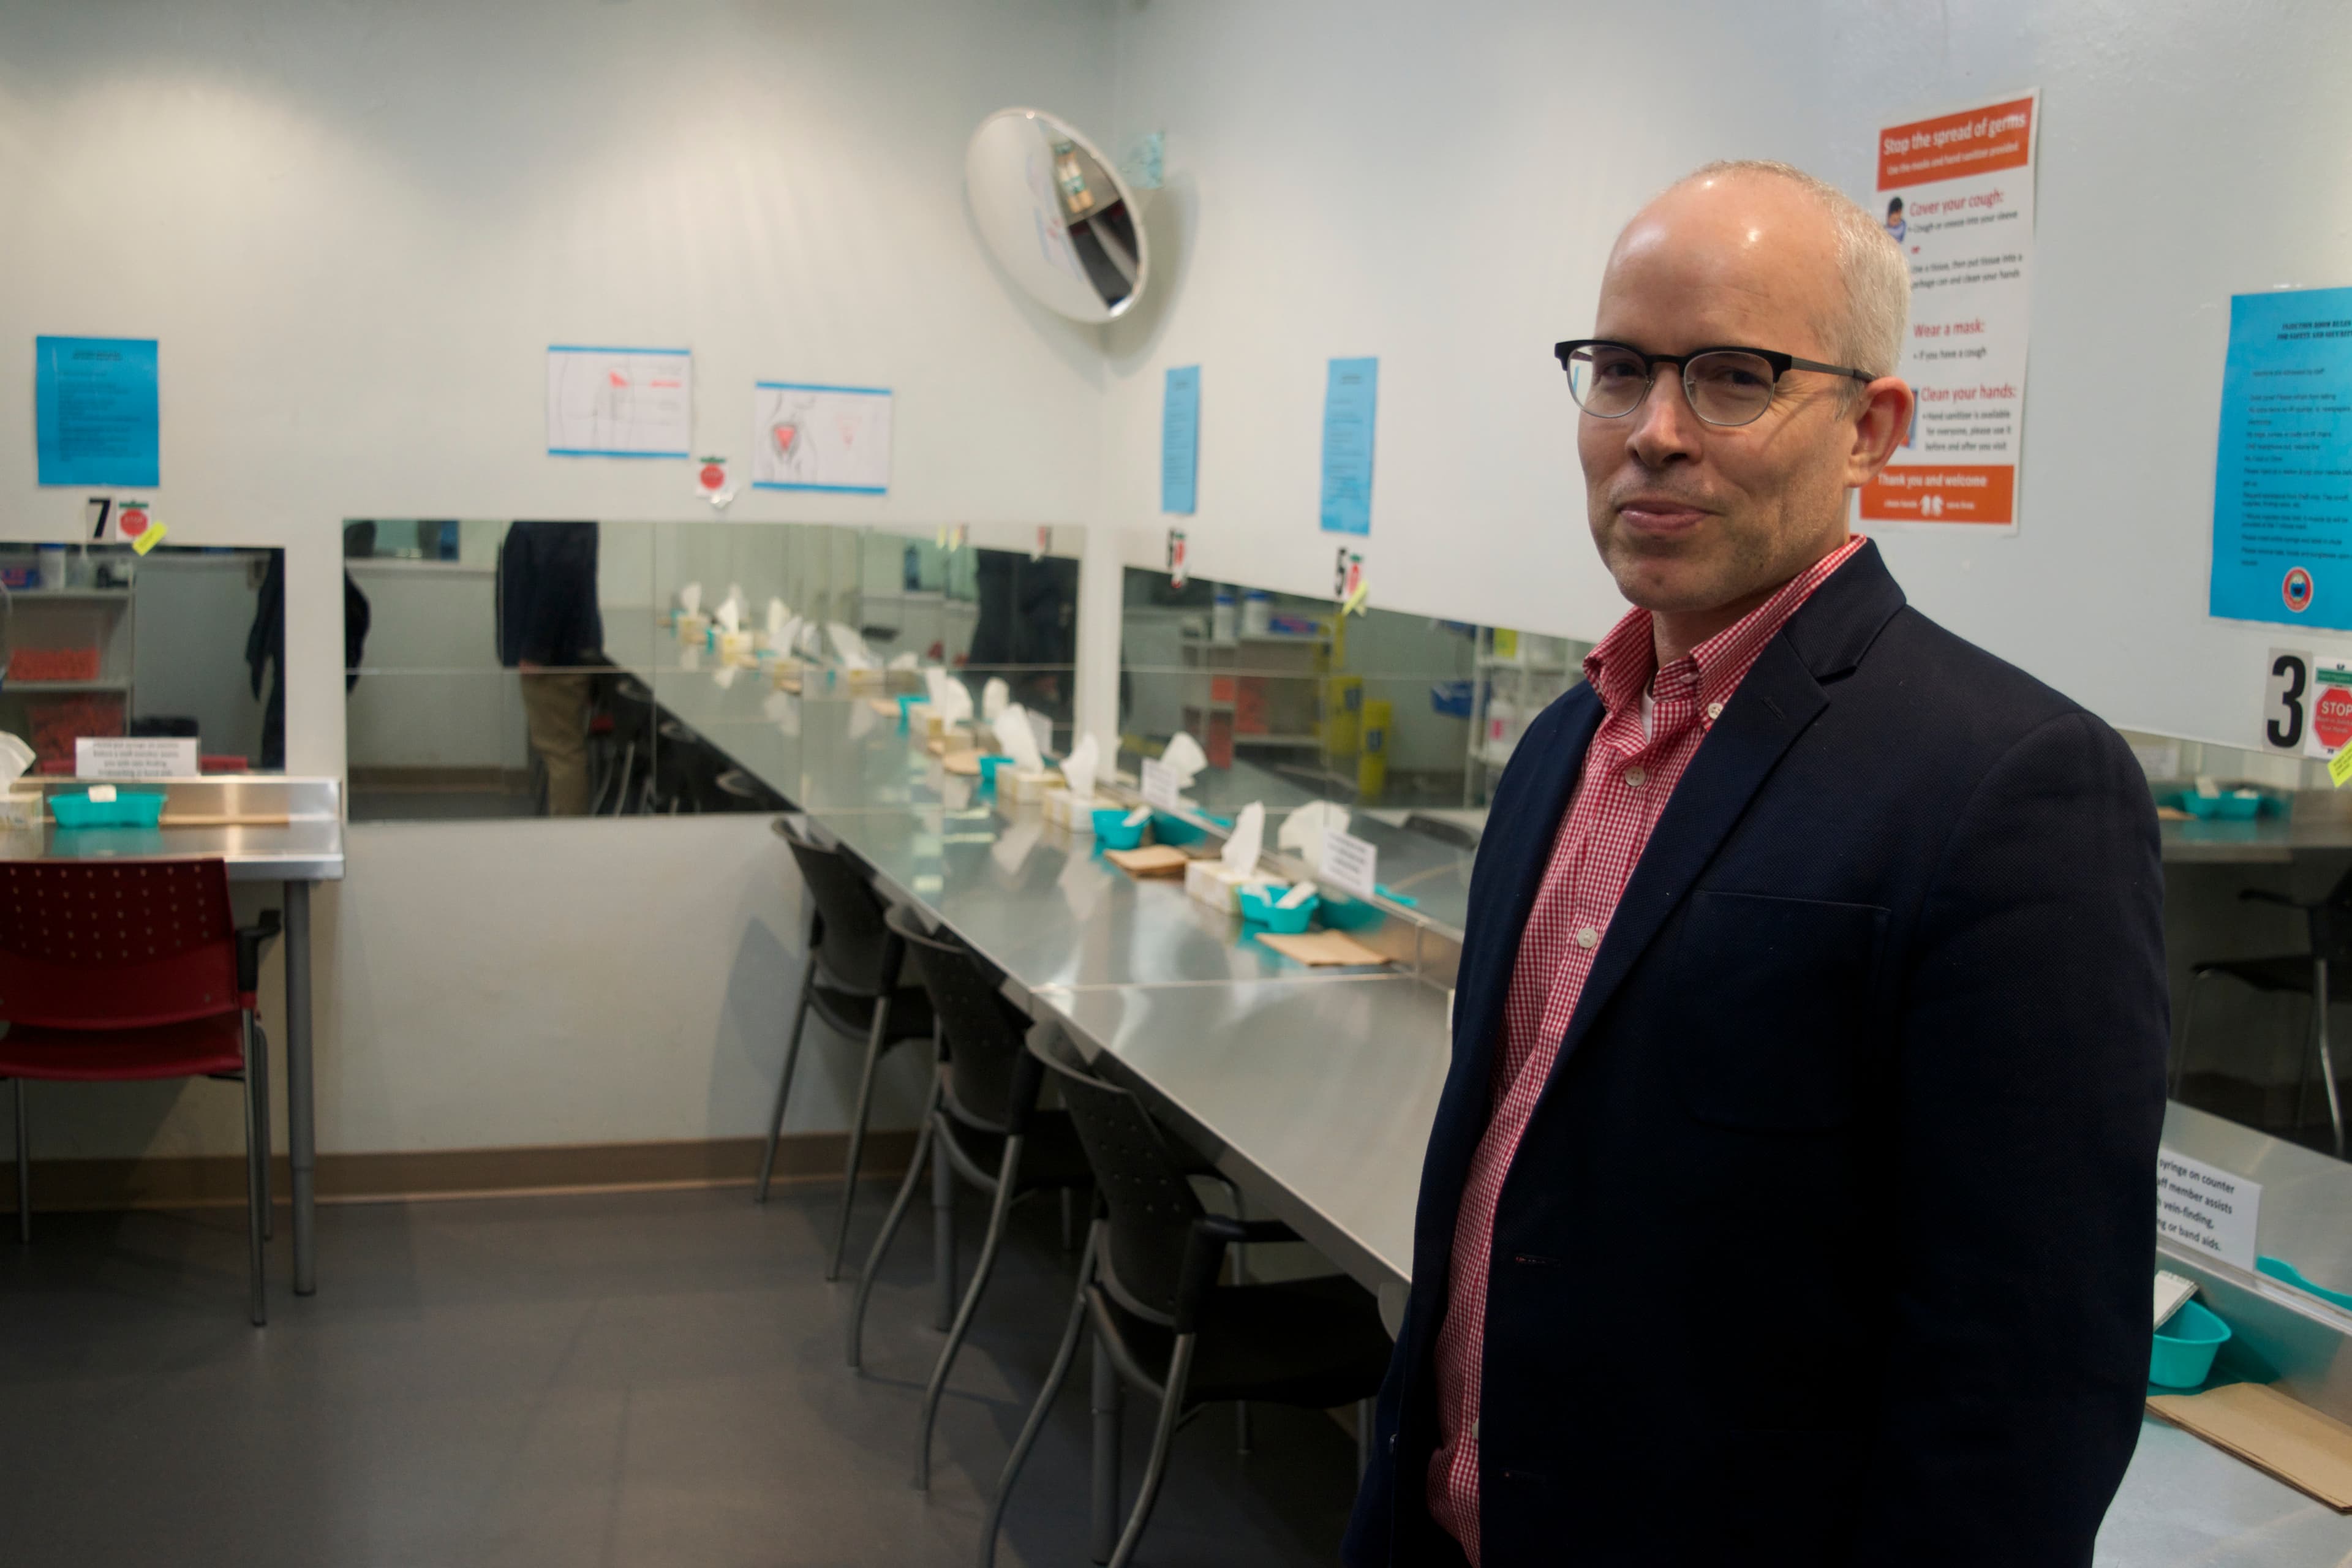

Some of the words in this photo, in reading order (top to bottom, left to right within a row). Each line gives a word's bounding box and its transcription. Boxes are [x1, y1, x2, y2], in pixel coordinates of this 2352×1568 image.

[1883, 138, 1909, 155] Stop
[1912, 132, 1930, 149] the
[1932, 121, 1972, 148] spread
[1974, 117, 1987, 137] of
[1988, 113, 2026, 138] germs
[1909, 202, 1939, 216] Cover
[1942, 197, 1966, 215] your
[1968, 187, 2005, 208] cough:
[1911, 279, 1934, 289] arbage
[1913, 323, 1941, 337] Wear
[1944, 325, 1950, 336] a
[1953, 317, 1985, 333] mask:
[1925, 352, 1937, 361] you
[1940, 349, 1956, 358] have
[1964, 345, 1986, 360] cough
[1921, 386, 1949, 402] Clean
[1951, 387, 1977, 403] your
[1980, 383, 2016, 399] hands:
[1878, 472, 1905, 486] Thank
[1907, 475, 1923, 489] you
[1924, 473, 1943, 486] and
[1945, 473, 1987, 488] welcome
[89, 497, 110, 538] 7
[1335, 546, 1347, 597] 5
[2267, 655, 2306, 748] 3
[2322, 701, 2352, 716] STOP
[2160, 1158, 2187, 1177] syringe
[2189, 1170, 2199, 1181] on
[2202, 1175, 2234, 1194] counter
[2169, 1182, 2203, 1202] member
[2205, 1196, 2233, 1215] assists
[2164, 1200, 2214, 1229] vein-finding,
[2168, 1223, 2177, 1232] or
[2179, 1224, 2199, 1242] band
[2202, 1236, 2221, 1251] aids.
